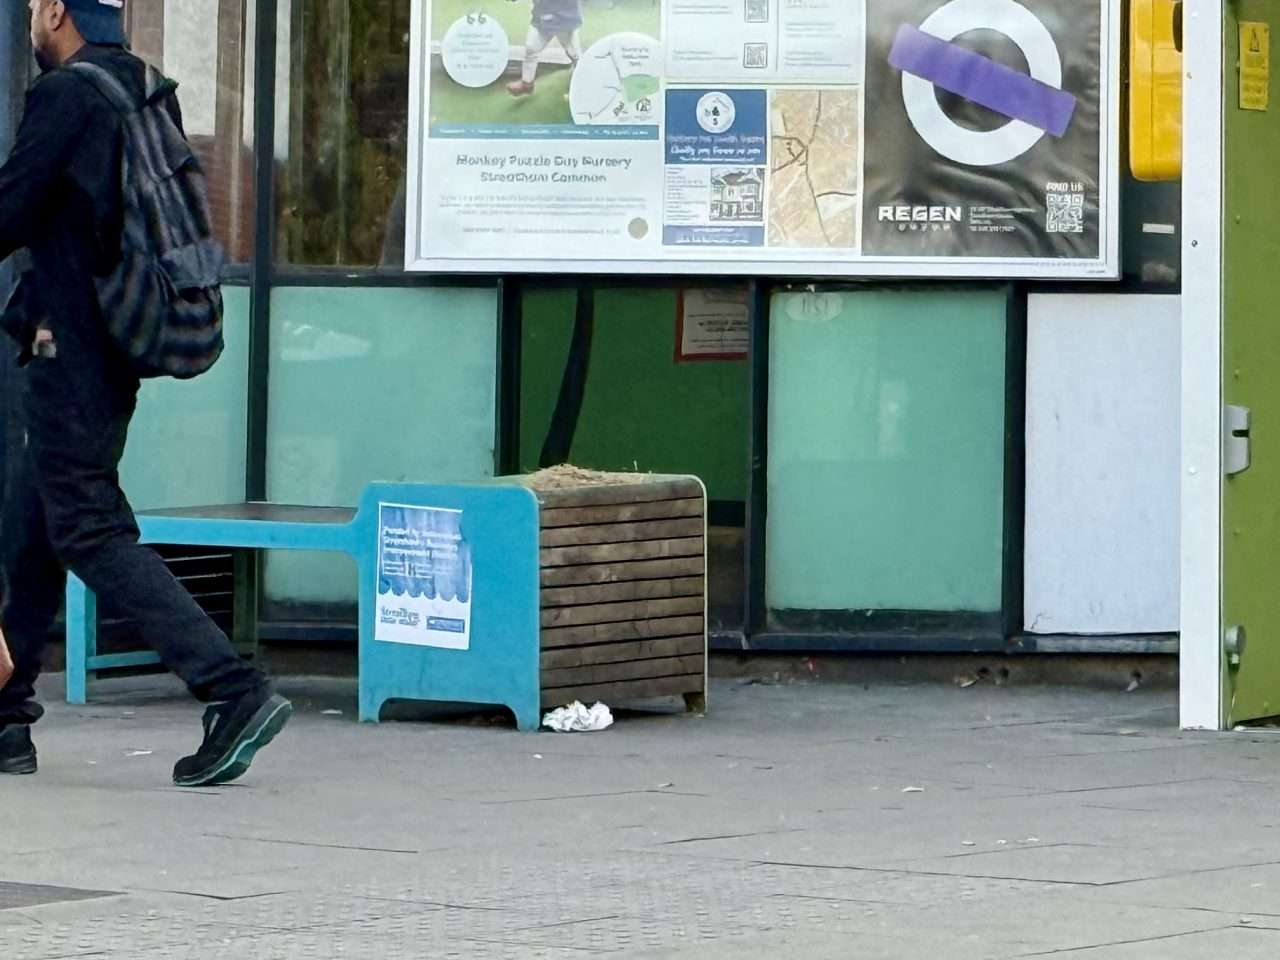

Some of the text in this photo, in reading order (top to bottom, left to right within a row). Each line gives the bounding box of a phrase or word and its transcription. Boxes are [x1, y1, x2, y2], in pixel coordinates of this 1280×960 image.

[455, 154, 506, 169] Monkey
[509, 154, 551, 167] Puzzle
[552, 171, 607, 183] Common
[878, 205, 962, 222] REGEN
